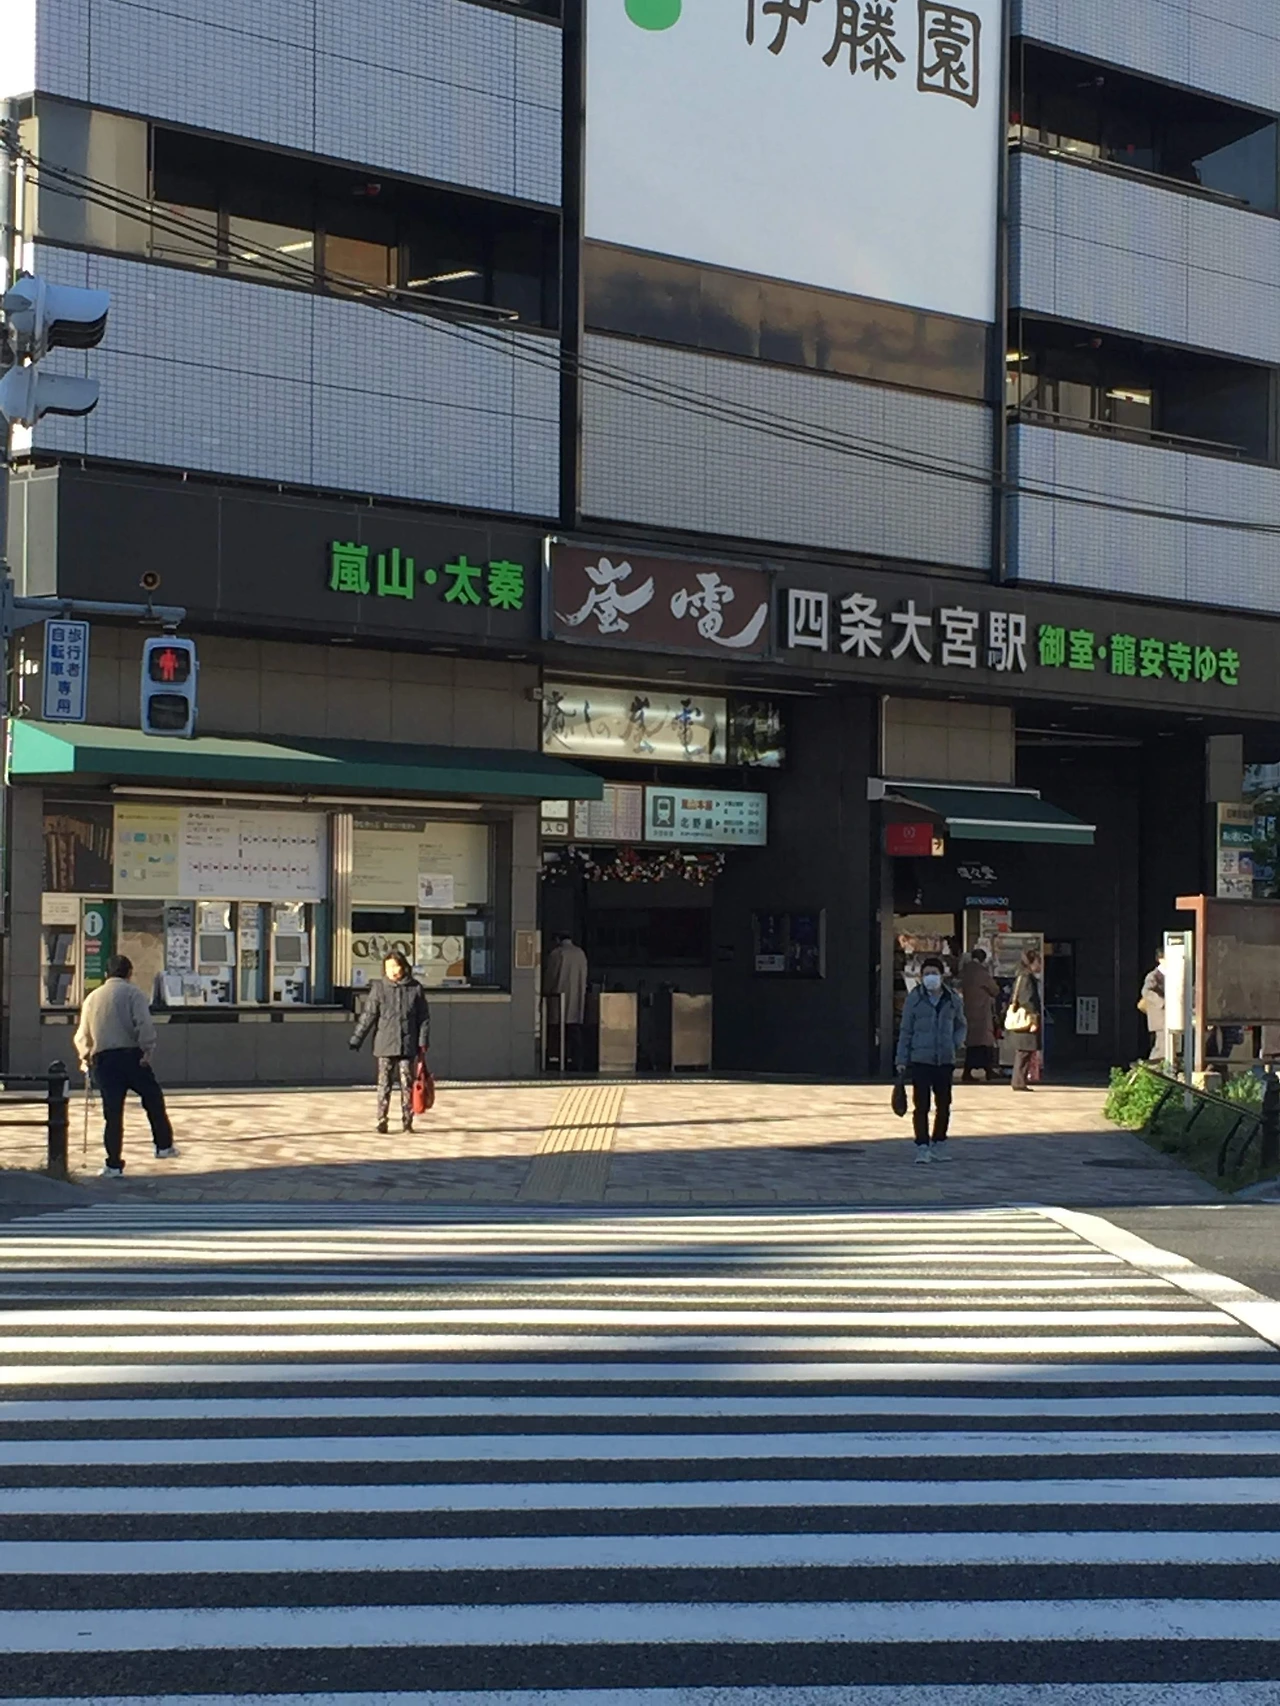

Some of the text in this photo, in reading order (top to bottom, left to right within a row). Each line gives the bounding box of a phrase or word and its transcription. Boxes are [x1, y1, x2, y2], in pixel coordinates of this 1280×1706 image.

[331, 541, 525, 609] 嵐山・太秦
[557, 556, 766, 648] 嵐電
[51, 627, 65, 675] 自転車
[67, 627, 82, 677] 歩行者
[786, 588, 1028, 672] 四条大宮駅
[1038, 624, 1240, 686] 御室・龍安寺ゆき
[56, 680, 71, 714] 専用
